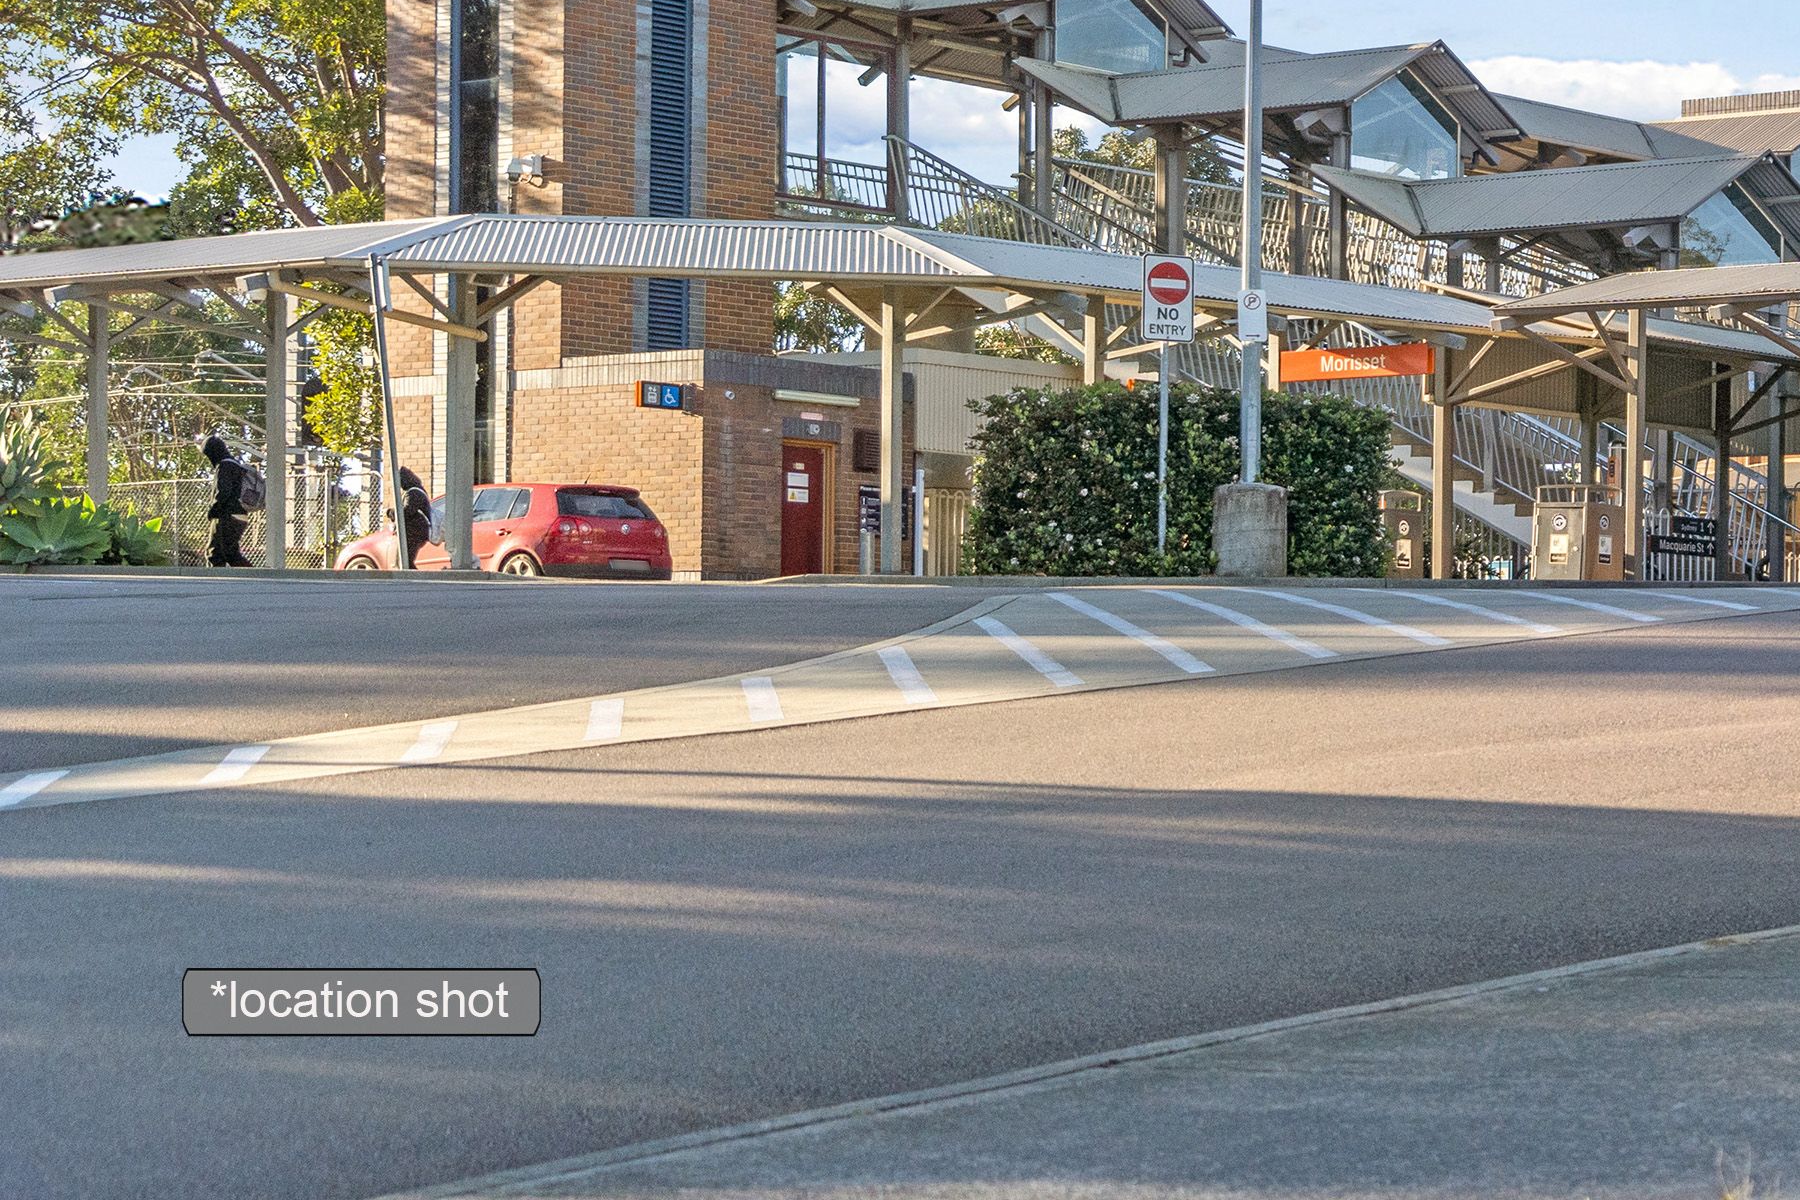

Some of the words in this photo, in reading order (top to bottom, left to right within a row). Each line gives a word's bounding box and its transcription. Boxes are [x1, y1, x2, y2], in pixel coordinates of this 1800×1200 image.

[1157, 307, 1179, 321] NO
[1149, 323, 1187, 336] ENTRY
[1320, 354, 1386, 373] Morisset
[1660, 539, 1697, 553] Macquarie
[1697, 542, 1705, 553] St
